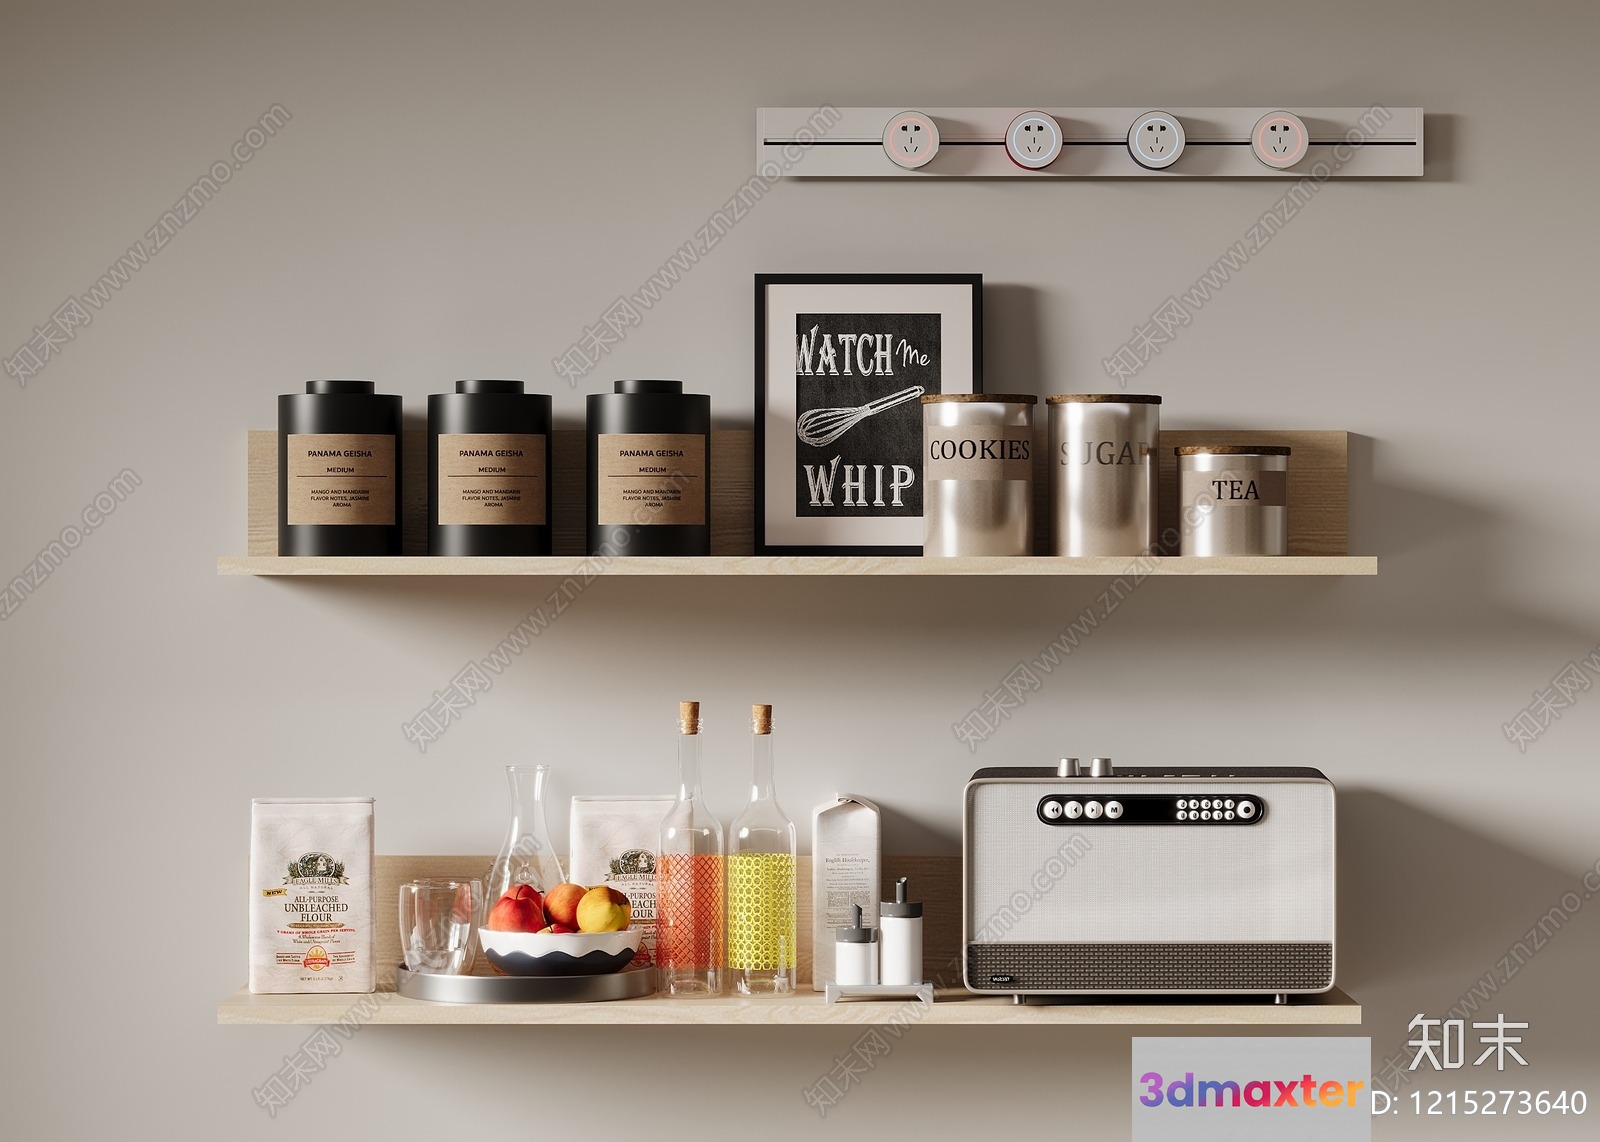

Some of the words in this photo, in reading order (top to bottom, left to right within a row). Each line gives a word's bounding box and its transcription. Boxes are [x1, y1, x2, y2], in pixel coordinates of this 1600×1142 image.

[796, 323, 894, 377] WATCH
[895, 338, 931, 368] Me
[930, 439, 1030, 461] COOKIES
[803, 454, 915, 507] WHIP
[1212, 479, 1260, 500] TEA
[284, 904, 348, 912] UNBLEACHED
[301, 913, 332, 922] FLOUR
